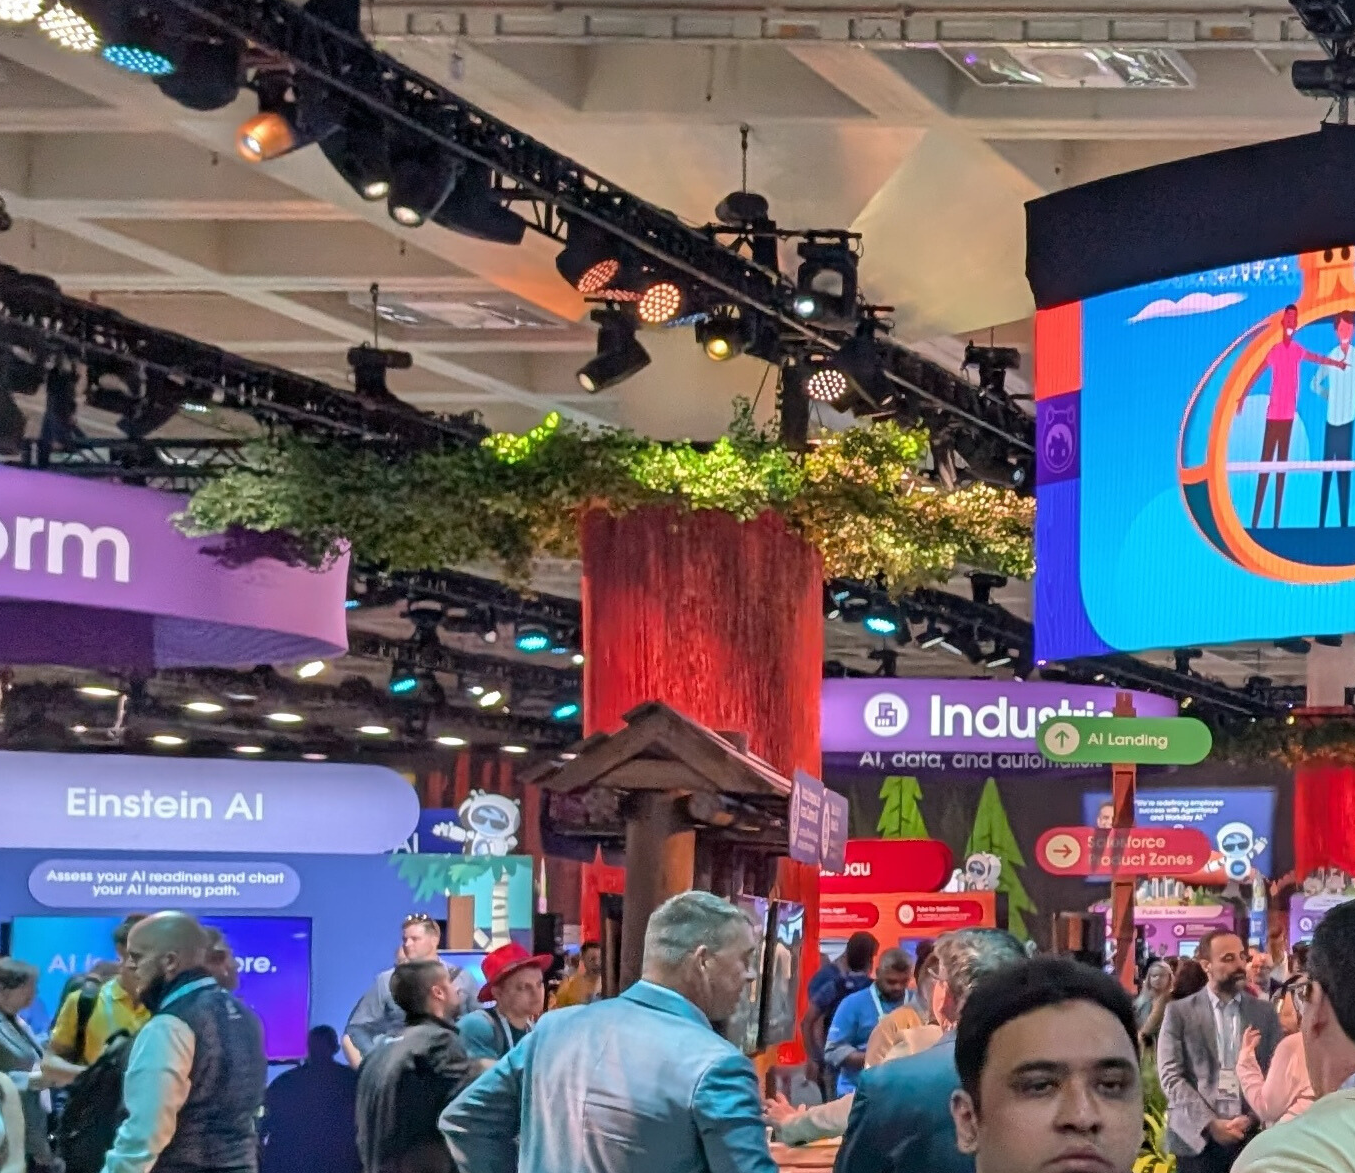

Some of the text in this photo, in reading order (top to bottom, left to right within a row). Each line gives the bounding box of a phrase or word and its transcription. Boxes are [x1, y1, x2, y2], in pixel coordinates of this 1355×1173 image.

[0, 516, 130, 583] rm
[1087, 732, 1168, 748] AI Landing
[860, 751, 884, 769] AI,
[892, 751, 945, 770] data,
[952, 752, 993, 768] and
[67, 787, 263, 821] Einstein AI
[1149, 852, 1194, 866] Zones
[47, 870, 284, 884] Assess your AI readiness and chart
[93, 885, 240, 898] your AI learning path.
